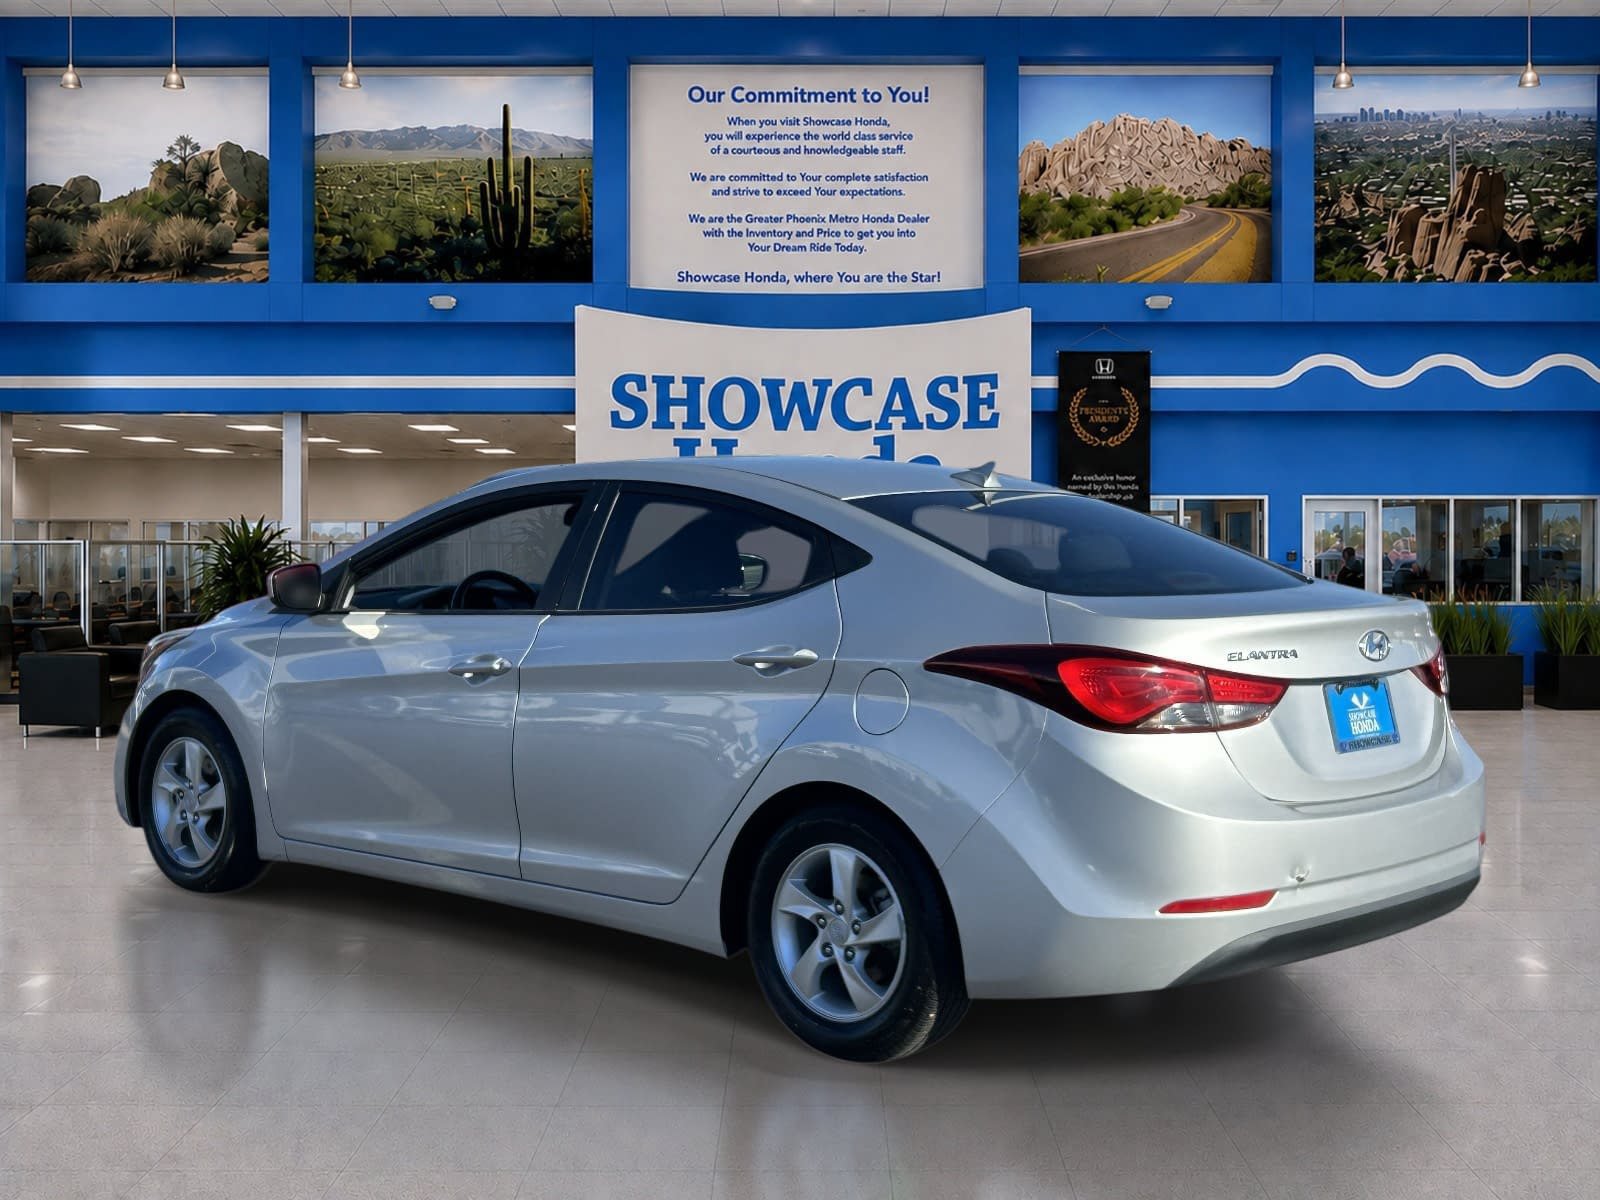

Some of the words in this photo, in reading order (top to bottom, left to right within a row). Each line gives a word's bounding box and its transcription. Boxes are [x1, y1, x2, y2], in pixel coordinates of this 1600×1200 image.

[687, 85, 726, 104] Our
[730, 85, 857, 104] Commitment
[861, 87, 883, 104] to
[886, 85, 930, 104] You!
[726, 116, 757, 127] When
[758, 118, 778, 129] you
[779, 116, 801, 127] visit
[802, 116, 853, 127] Showcase
[854, 116, 891, 129] Honda,
[704, 133, 724, 144] you
[725, 130, 743, 141] will
[744, 130, 801, 144] experience
[802, 130, 820, 141] the
[821, 130, 851, 141] world
[853, 130, 877, 141] class
[878, 130, 914, 141] service
[710, 144, 721, 155] of
[722, 146, 730, 156] a
[730, 146, 781, 156] courteous
[782, 144, 802, 155] and
[881, 144, 907, 155] staff.
[689, 172, 708, 183] We
[709, 174, 727, 183] are
[728, 171, 784, 183] committed
[786, 173, 798, 183] to
[799, 172, 823, 183] Your
[824, 172, 872, 185] complete
[873, 171, 929, 183] satisfaction
[711, 186, 731, 197] and
[732, 186, 761, 197] strive
[762, 187, 774, 197] to
[775, 186, 812, 197] exceed
[814, 186, 838, 197] Your
[839, 186, 906, 200] expectations.
[688, 213, 706, 224] We
[707, 215, 725, 224] are
[726, 213, 743, 224] the
[744, 213, 784, 224] Greater
[785, 213, 827, 224] Phoenix
[828, 213, 860, 224] Metro
[861, 213, 895, 224] Honda
[897, 213, 931, 224] Dealer
[702, 227, 725, 238] with
[726, 227, 744, 238] the
[745, 227, 794, 241] Inventory
[795, 227, 815, 238] and
[816, 227, 842, 238] Price
[843, 228, 855, 238] to
[856, 229, 875, 241] get
[876, 230, 895, 241] you
[896, 227, 917, 238] into
[747, 242, 772, 253] Your
[773, 242, 808, 253] Dream
[809, 242, 833, 253] Ride
[834, 242, 868, 255] Today.
[677, 270, 741, 284] Showcase
[744, 270, 790, 286] Honda,
[793, 270, 834, 284] where
[836, 271, 861, 284] You
[863, 274, 884, 284] are
[886, 270, 908, 284] the
[911, 271, 942, 284] Star!
[609, 372, 1001, 431] SHOWCASE
[1088, 415, 1120, 423] AWARD
[1083, 474, 1115, 482] exclusive
[1226, 648, 1299, 662] ELANTRA
[1350, 717, 1381, 735] HONDA
